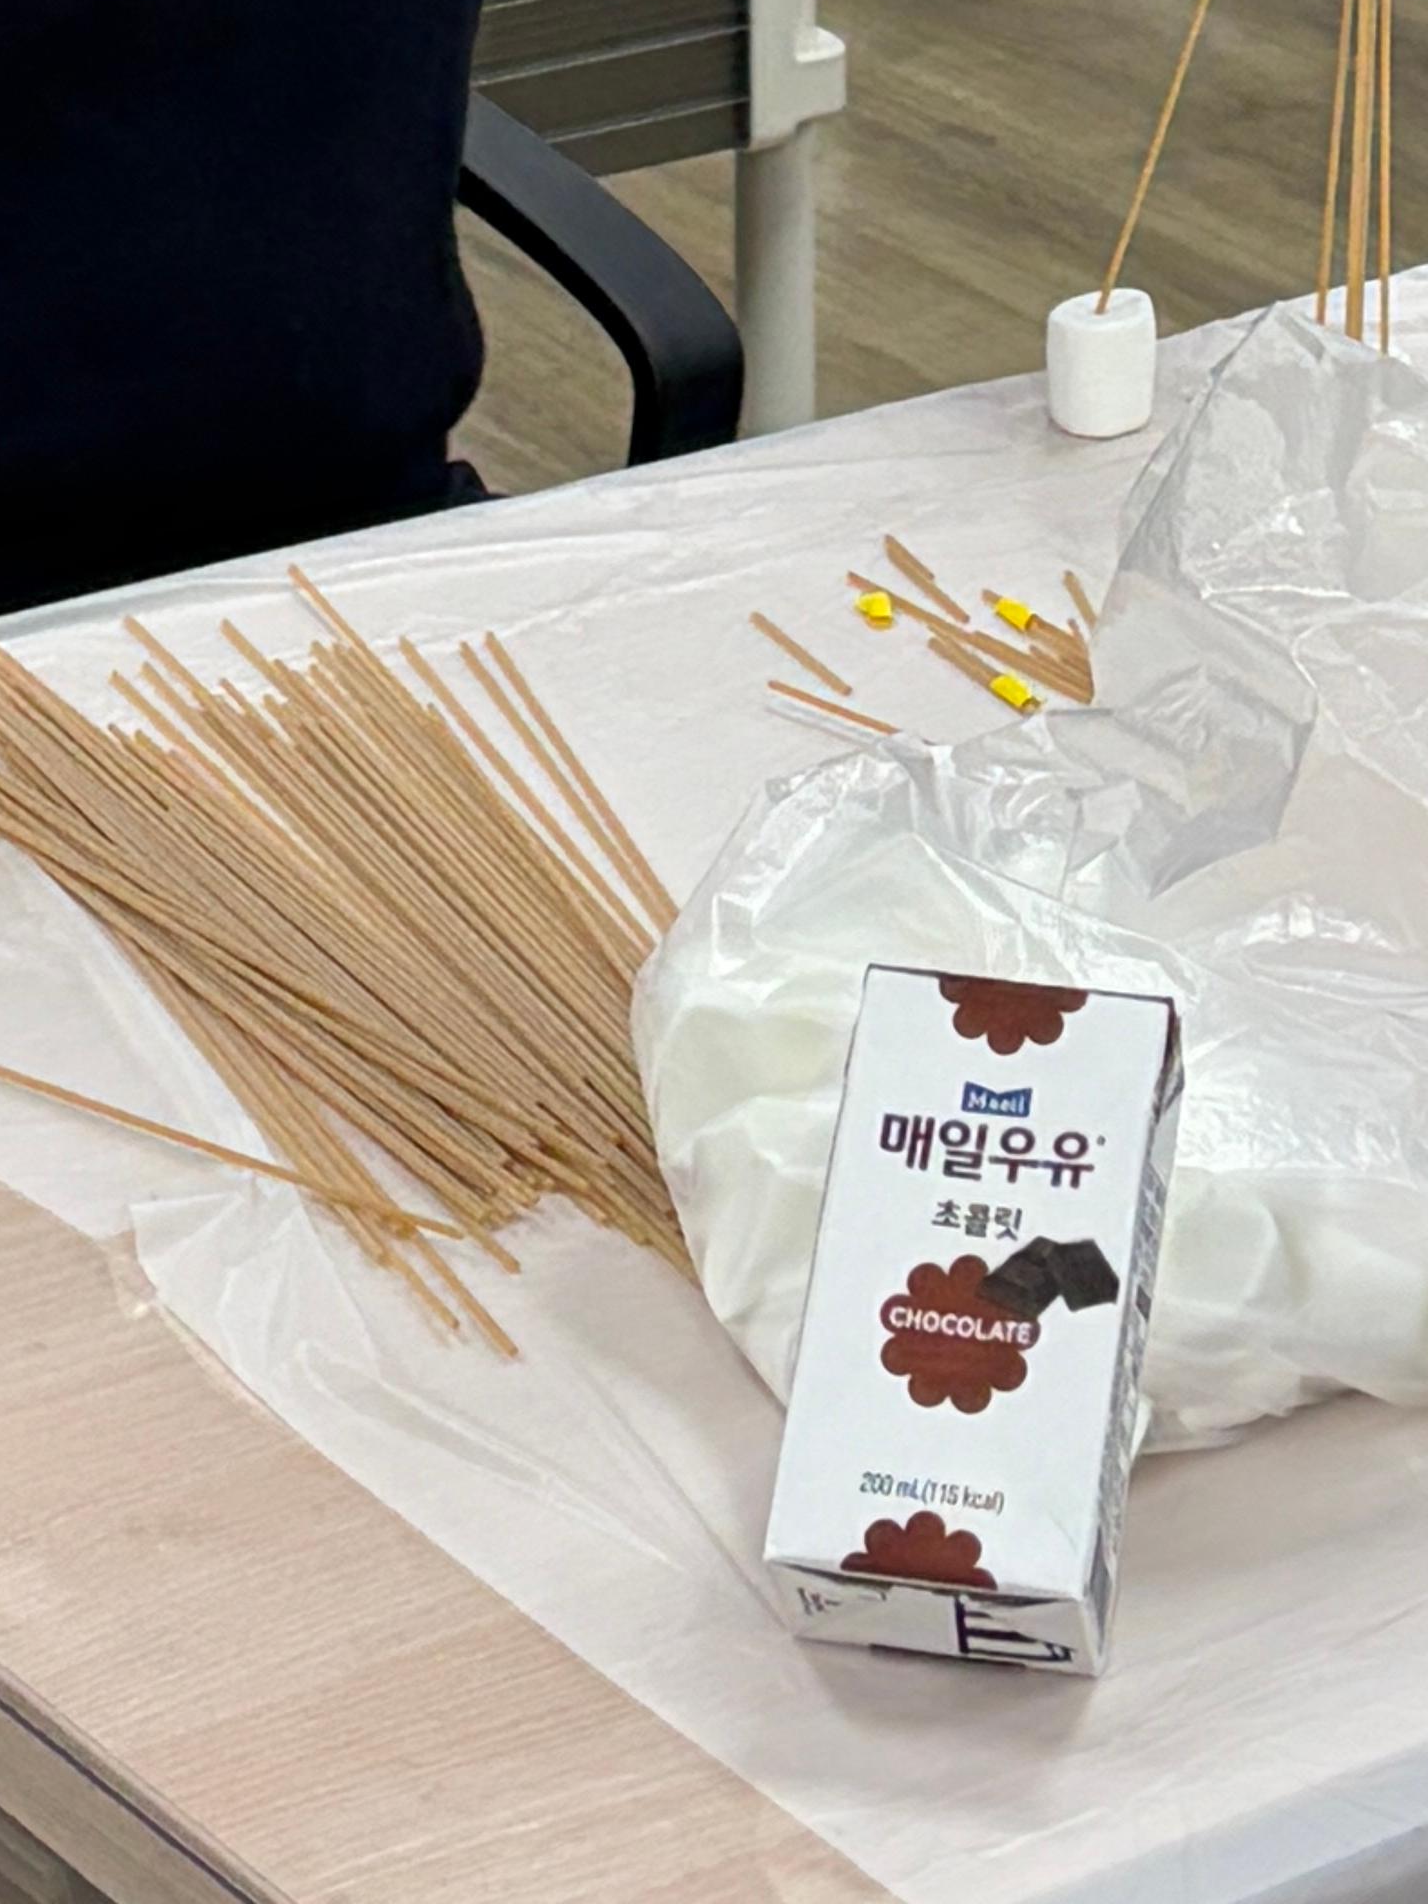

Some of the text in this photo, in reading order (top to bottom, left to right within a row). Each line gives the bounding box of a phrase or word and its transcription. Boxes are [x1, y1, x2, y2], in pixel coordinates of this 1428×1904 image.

[968, 1090, 1026, 1114] Maeil
[879, 1112, 1095, 1189] 매일우유
[931, 1199, 1023, 1242] 초콜릿
[889, 1305, 1033, 1345] CHOCOLATE
[859, 1470, 894, 1496] 200
[962, 1485, 1005, 1516] kcal)
